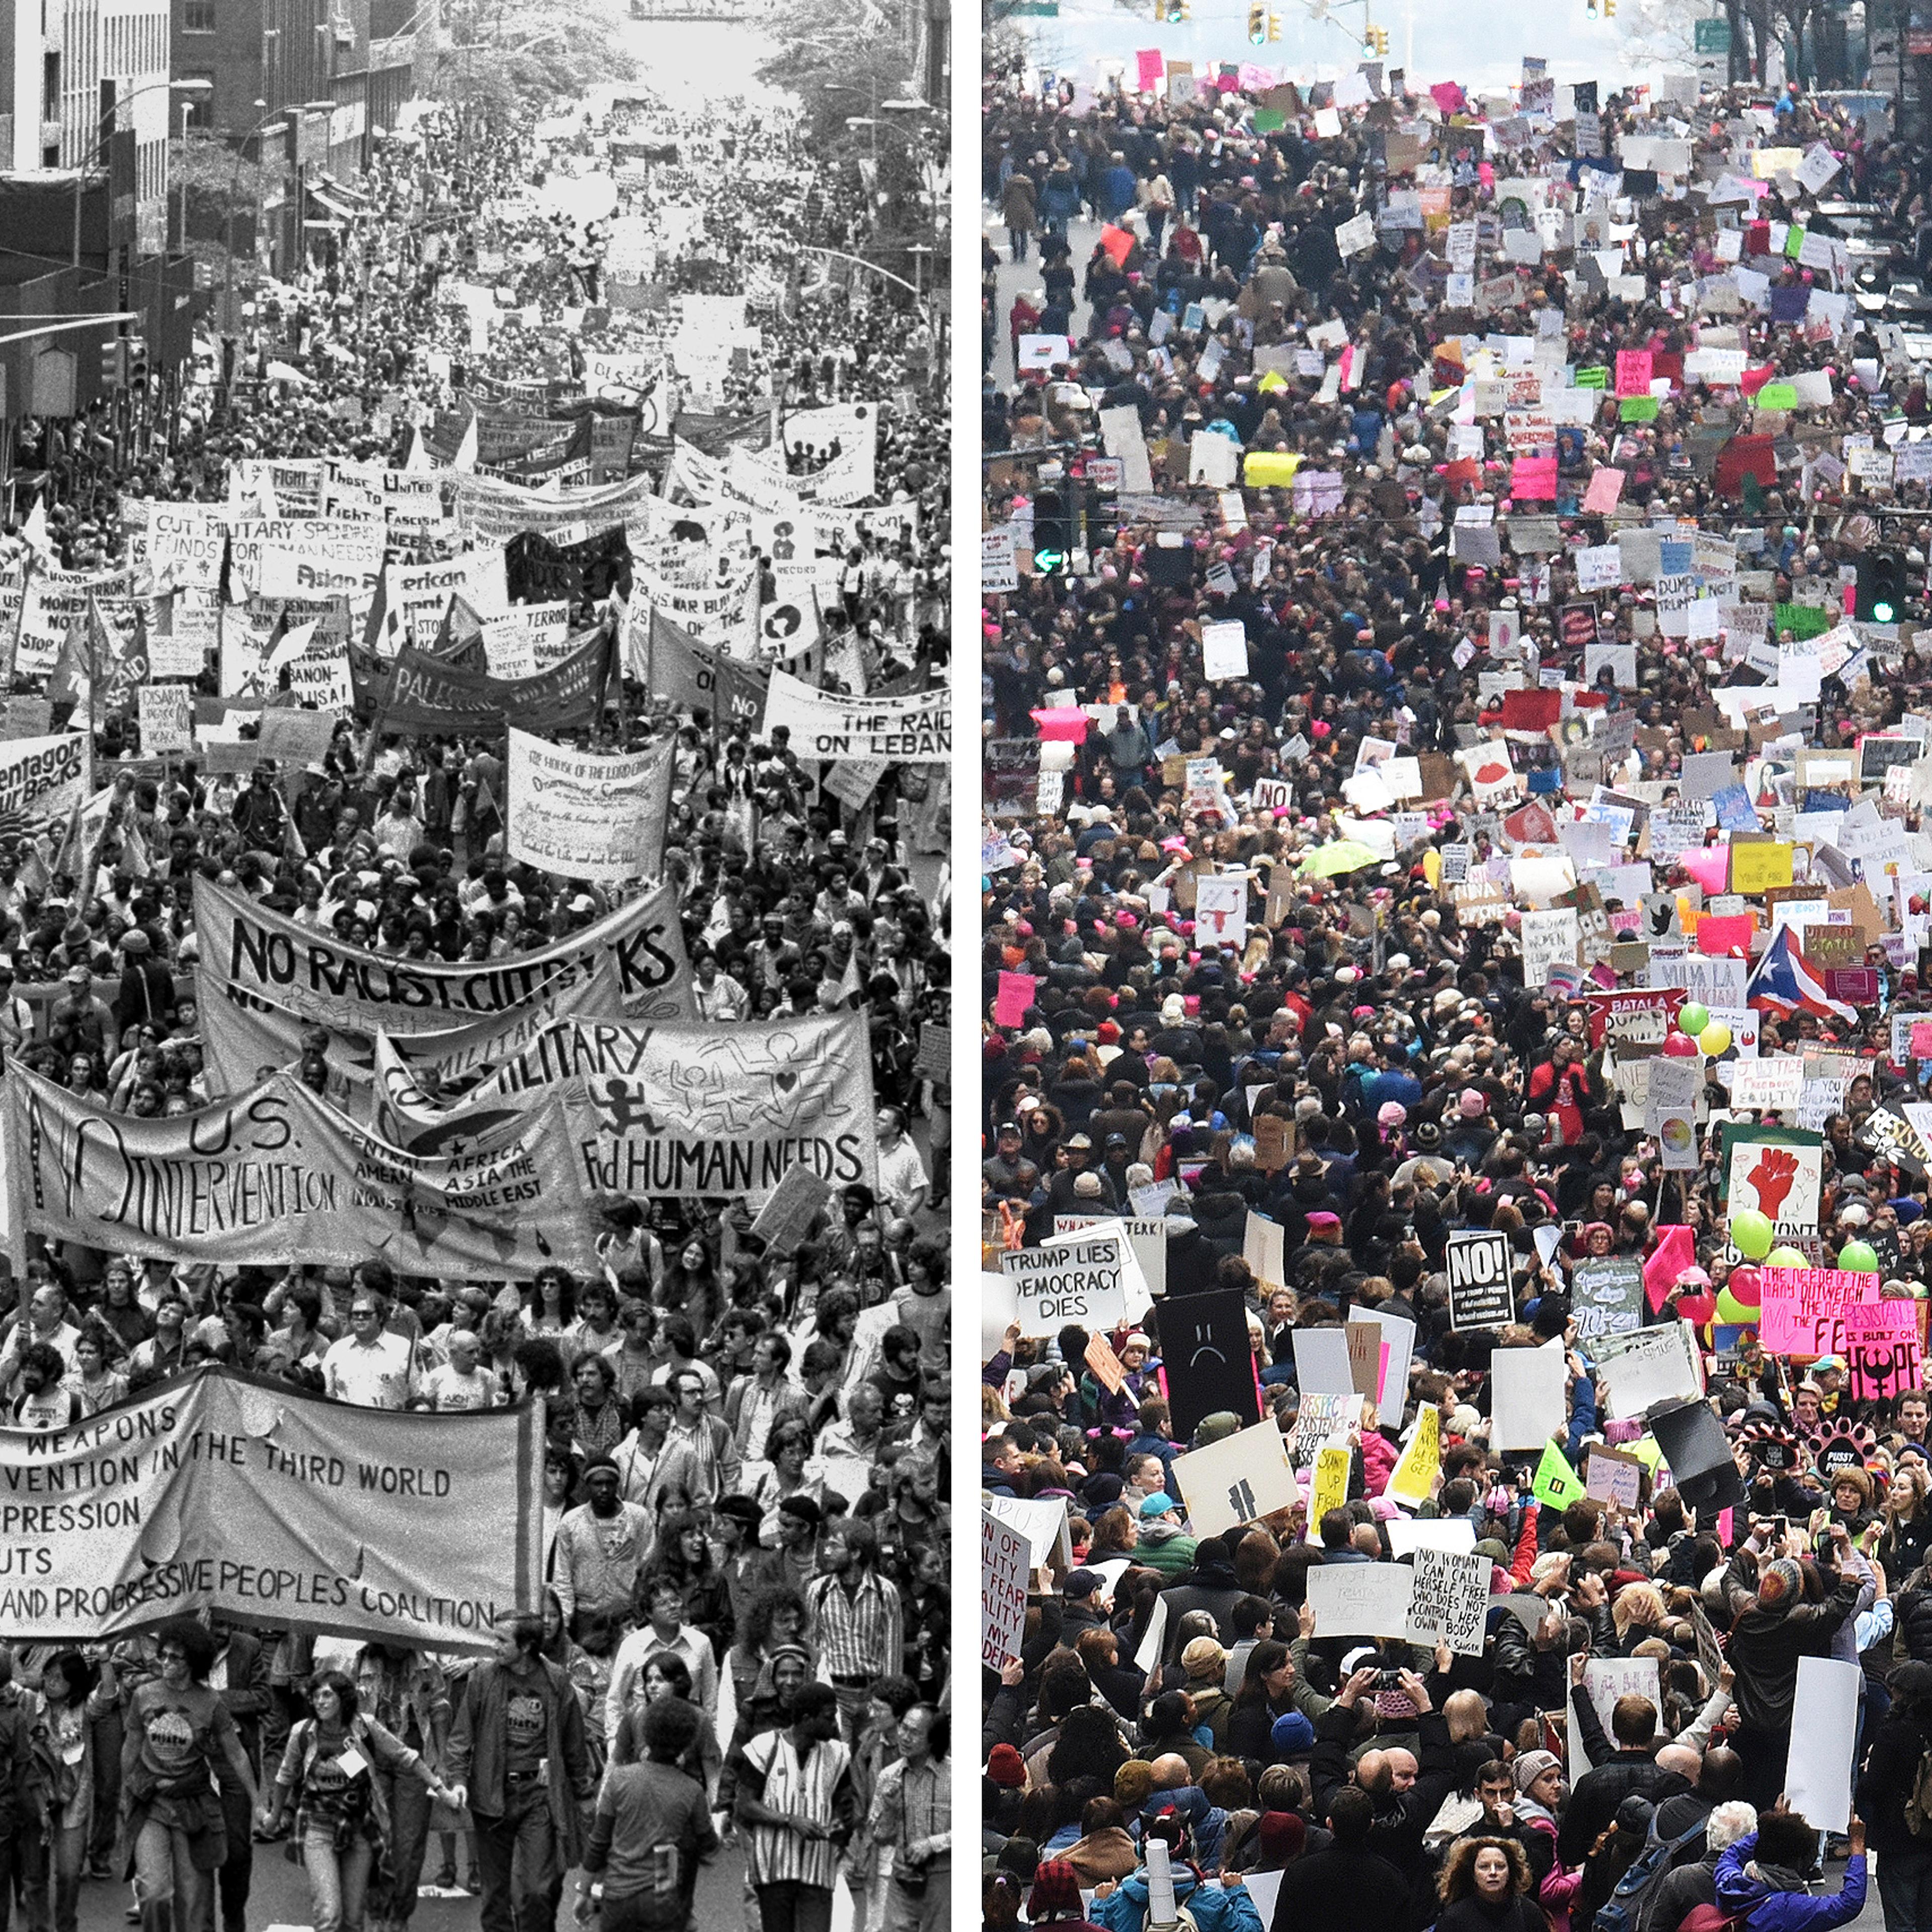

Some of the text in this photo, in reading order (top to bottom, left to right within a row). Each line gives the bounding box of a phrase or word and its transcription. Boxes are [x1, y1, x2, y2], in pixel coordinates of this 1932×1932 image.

[156, 515, 195, 535] CUT
[526, 608, 567, 628] TERROR
[20, 632, 55, 652] STOP
[308, 683, 347, 705] USA!
[841, 713, 890, 732] THE
[816, 734, 851, 754] ON
[1260, 785, 1287, 807] NO
[231, 918, 297, 985] NO
[1612, 997, 1668, 1013] BATALA
[1822, 1079, 1841, 1093] YOU
[189, 1097, 302, 1156] U.S.
[447, 1139, 526, 1174] AFRICA
[626, 1134, 864, 1191] HUMAN NEEDS
[444, 1157, 537, 1191] ASIA THE
[130, 1155, 336, 1239] INTERVENTION
[444, 1178, 542, 1209] MIDDLE EAST
[1006, 1244, 1116, 1272] TRUMP LIES
[1450, 1240, 1505, 1288] NO!
[1763, 1266, 1786, 1283] THE
[1850, 1272, 1873, 1290] THE
[1763, 1283, 1864, 1303] MANY OUTWEIGH
[1038, 1296, 1089, 1319] DIES
[1799, 1300, 1824, 1317] THE
[1792, 1315, 1847, 1356] THE FE
[1846, 1329, 1916, 1342] IS BUILT ON
[1300, 1394, 1350, 1418] RESPECT
[27, 1406, 177, 1456] WEAPONS
[4, 1431, 451, 1499] VENTION IN THE THIRD WORLD
[1410, 1460, 1432, 1476] GET
[1827, 1451, 1855, 1463] PUSSY
[3, 1495, 141, 1535] PRESSION
[1001, 1534, 1021, 1558] OF
[1418, 1548, 1480, 1571] NO WOMAN
[1423, 1564, 1483, 1585] CAN CALL
[1, 1558, 498, 1631] AND PROGRESSIVE PEOPLES COALITION
[990, 1573, 1025, 1607] FEAR
[1413, 1575, 1487, 1601] HERSELF FREE
[1412, 1602, 1481, 1627] CONTROL HER
[1436, 1594, 1460, 1609] DOES
[1465, 1600, 1487, 1616] NOT
[988, 1624, 1010, 1648] MY
[1414, 1617, 1476, 1639] OWN BODY
